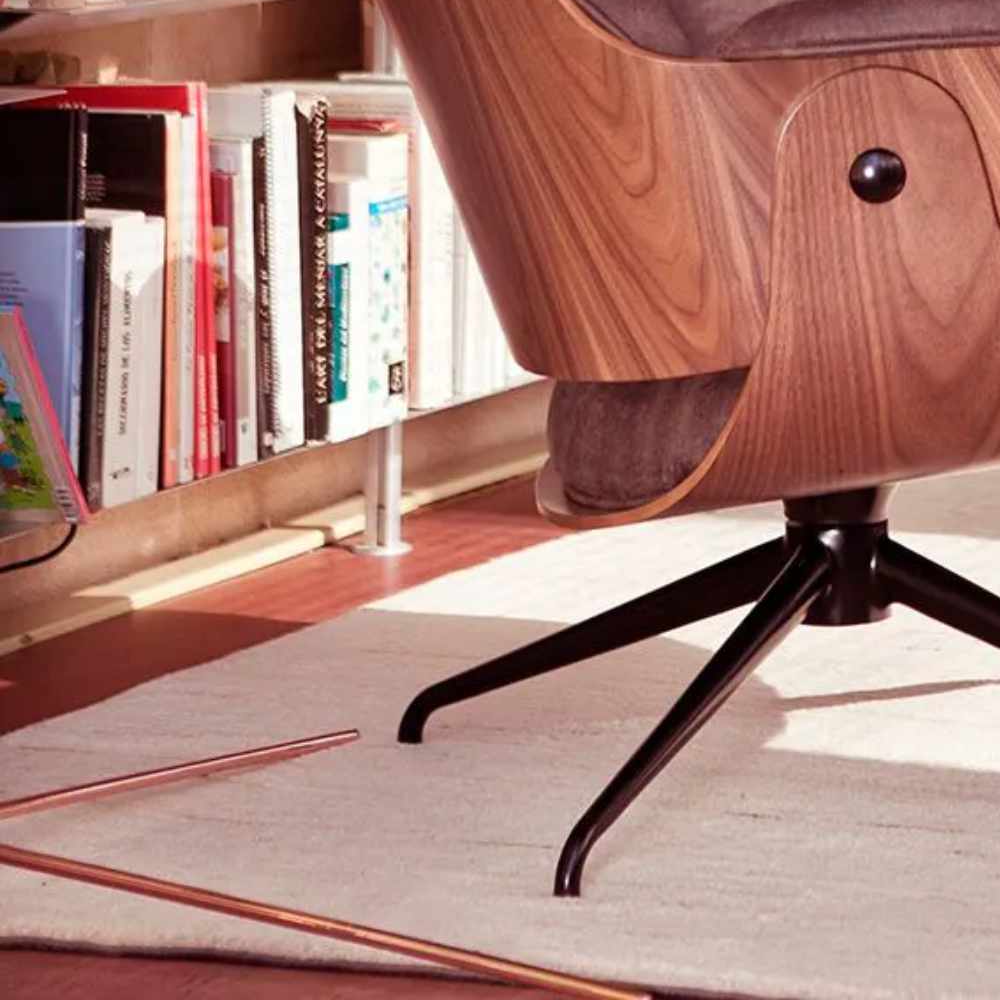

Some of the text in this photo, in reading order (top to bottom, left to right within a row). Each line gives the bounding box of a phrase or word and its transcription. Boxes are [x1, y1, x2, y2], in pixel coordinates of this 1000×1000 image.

[315, 215, 327, 229] A
[314, 312, 327, 349] DEL
[314, 356, 327, 404] L'ART
